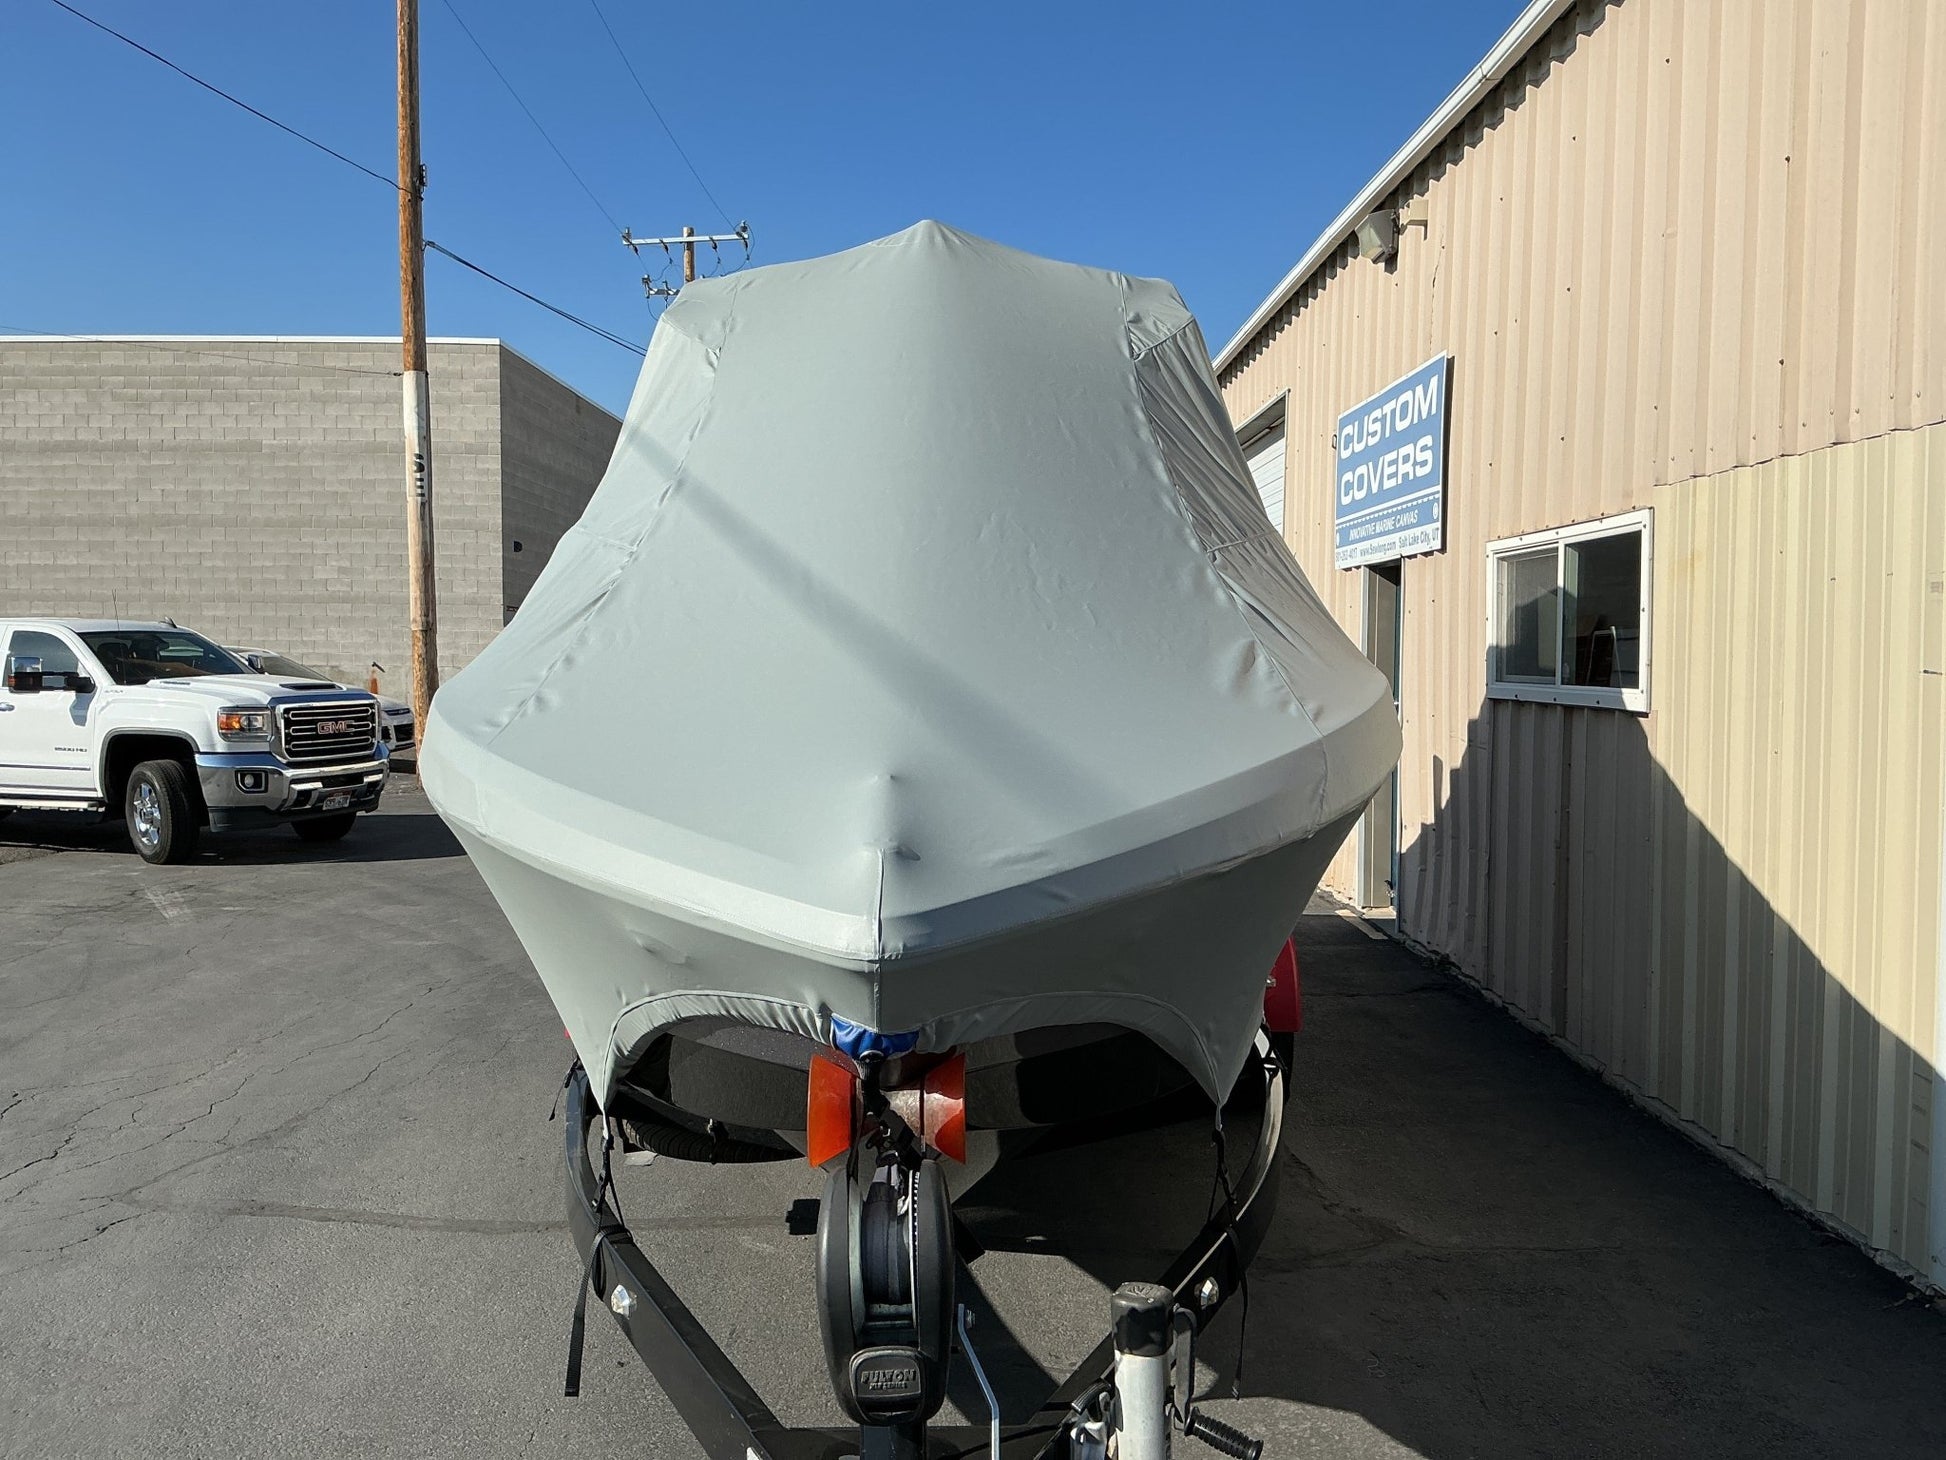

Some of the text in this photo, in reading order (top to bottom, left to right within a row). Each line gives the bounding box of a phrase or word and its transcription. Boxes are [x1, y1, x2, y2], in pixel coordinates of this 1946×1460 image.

[1340, 374, 1439, 460] CUSTOM
[1340, 434, 1434, 506] COVERS
[1349, 509, 1419, 541] INNOVATIVE MARINE CANVAS
[1399, 535, 1408, 548] Salt
[1409, 533, 1420, 546] Lake
[1432, 528, 1440, 541] UT
[317, 720, 355, 734] GMC
[861, 1369, 917, 1384] FULTON
